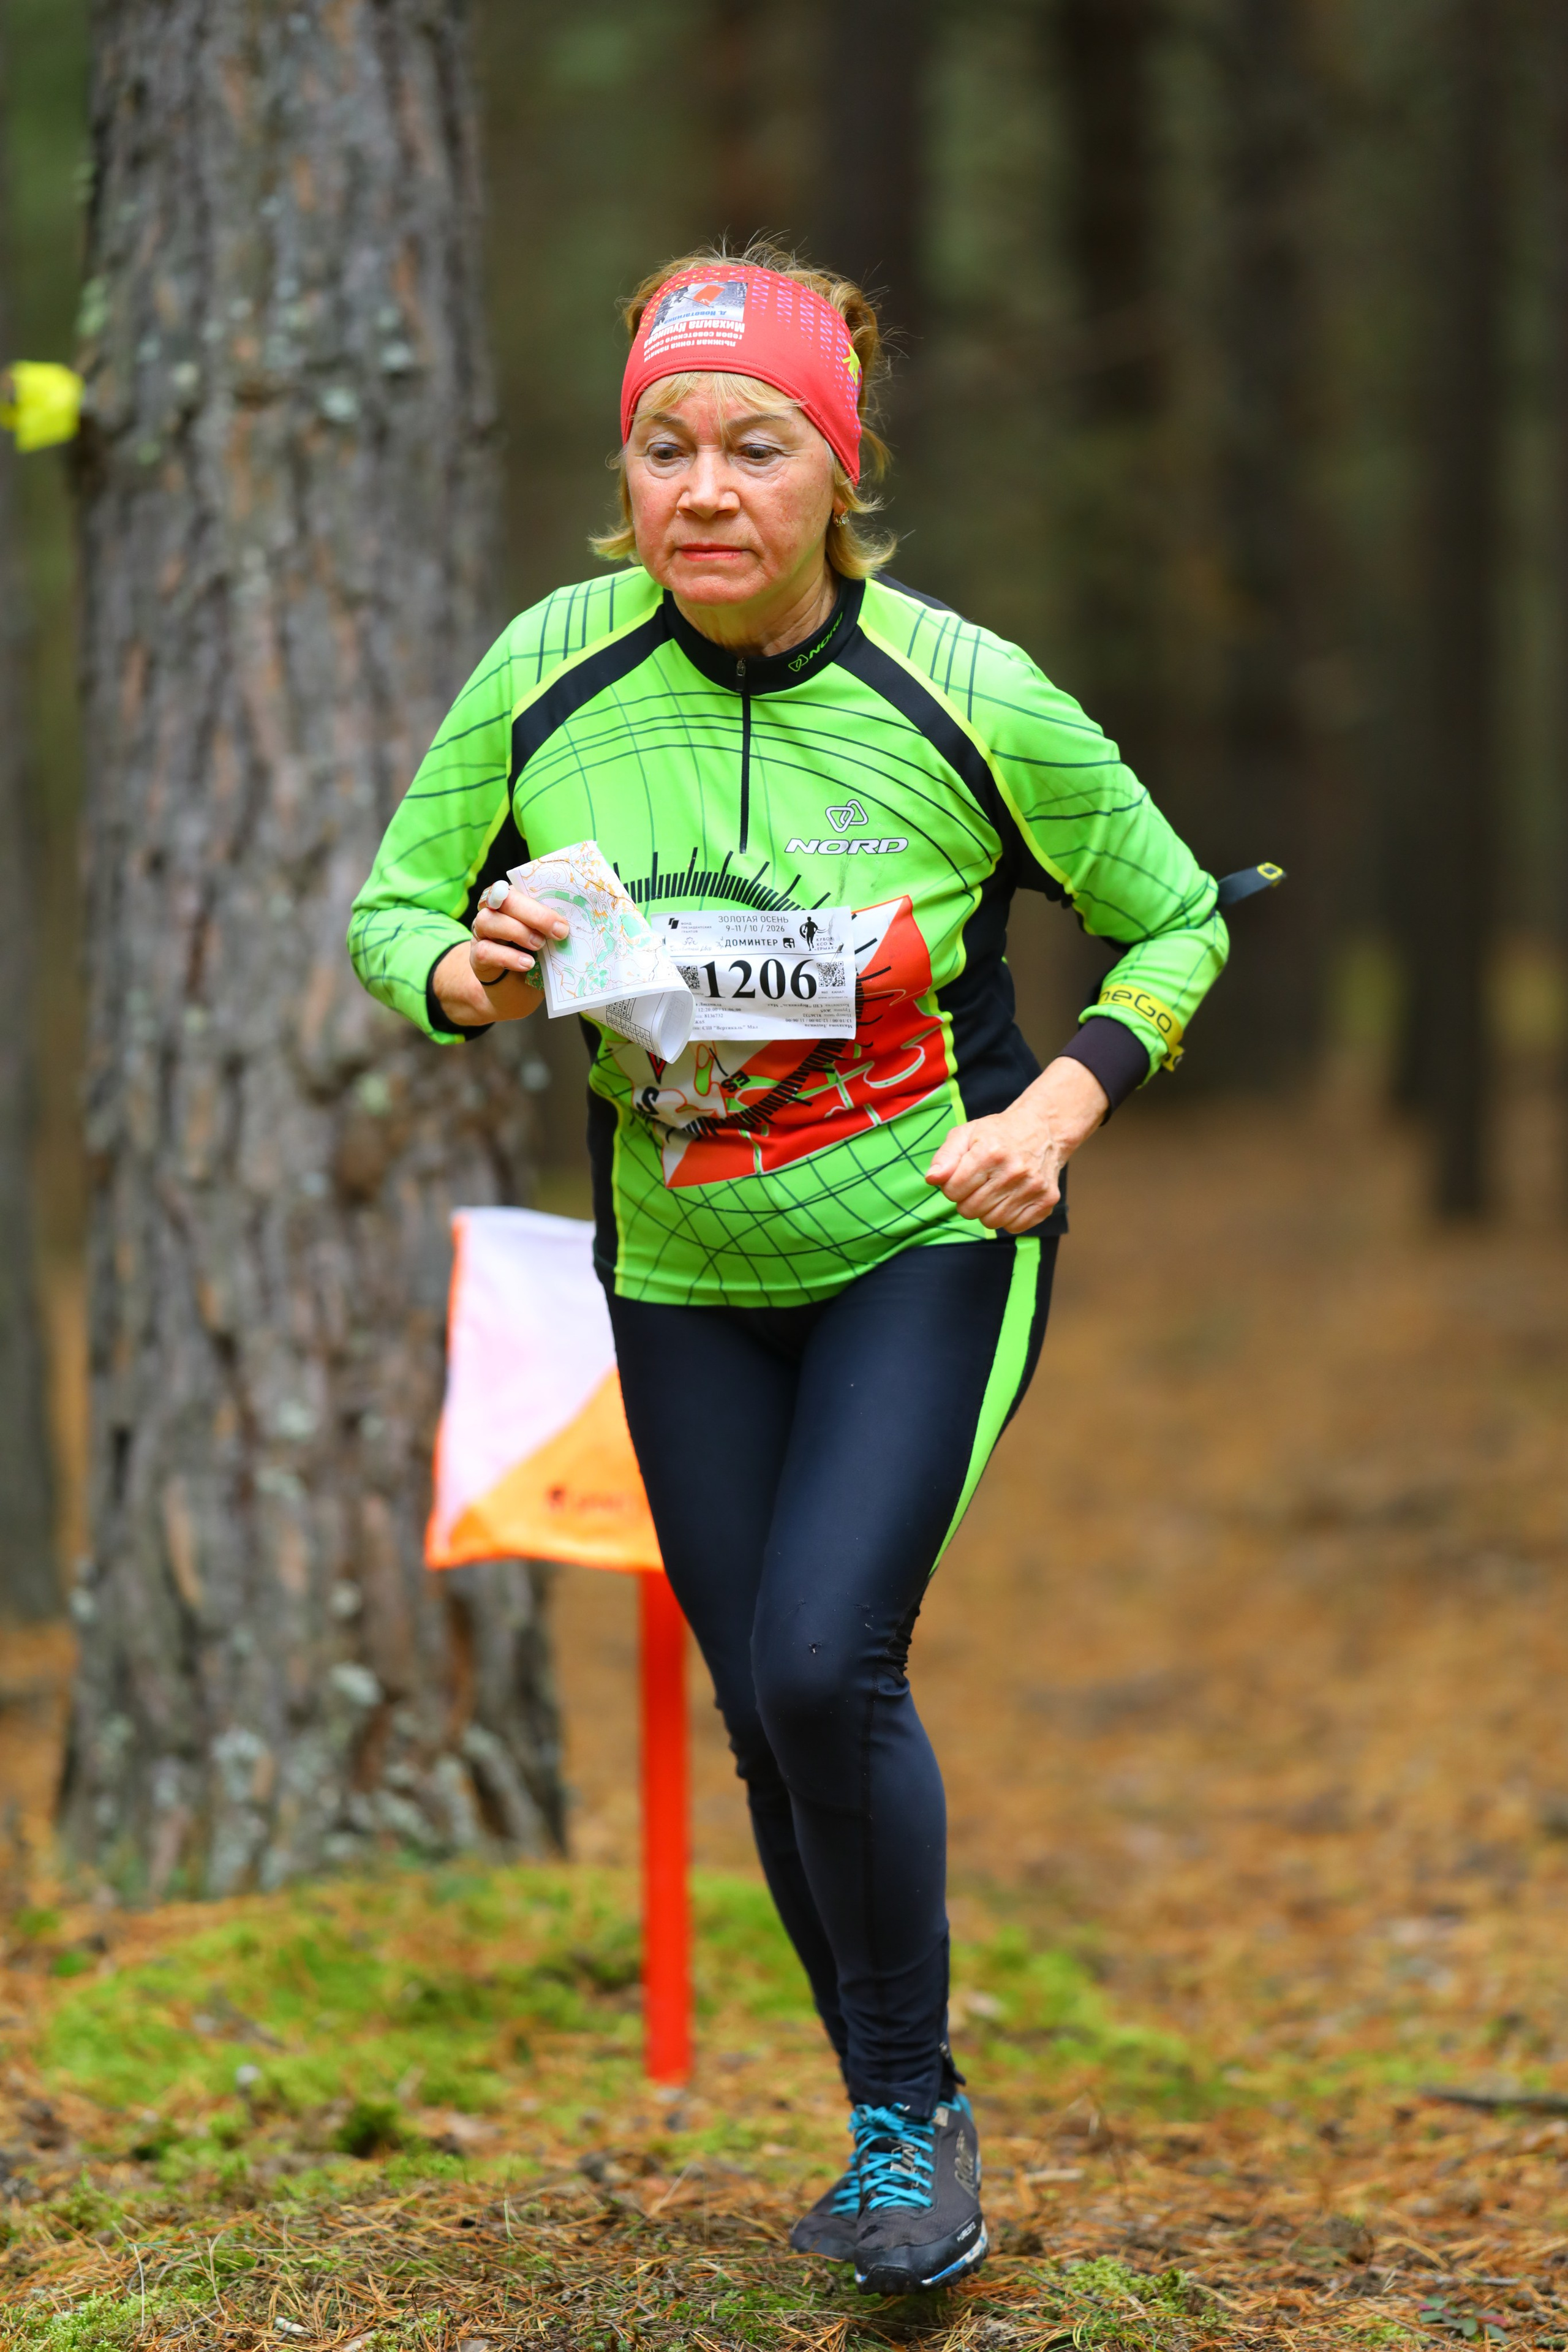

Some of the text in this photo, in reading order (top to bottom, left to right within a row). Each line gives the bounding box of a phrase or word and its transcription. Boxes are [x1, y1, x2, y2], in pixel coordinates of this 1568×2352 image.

[688, 319, 745, 333] Михаила
[644, 331, 743, 356] героя советского союза
[671, 340, 695, 350] гонка
[644, 344, 669, 363] памяти
[809, 612, 843, 659] NORD
[784, 838, 909, 855] NORD
[725, 939, 778, 948] ДОМИНТЕР
[699, 959, 817, 1000] 1206
